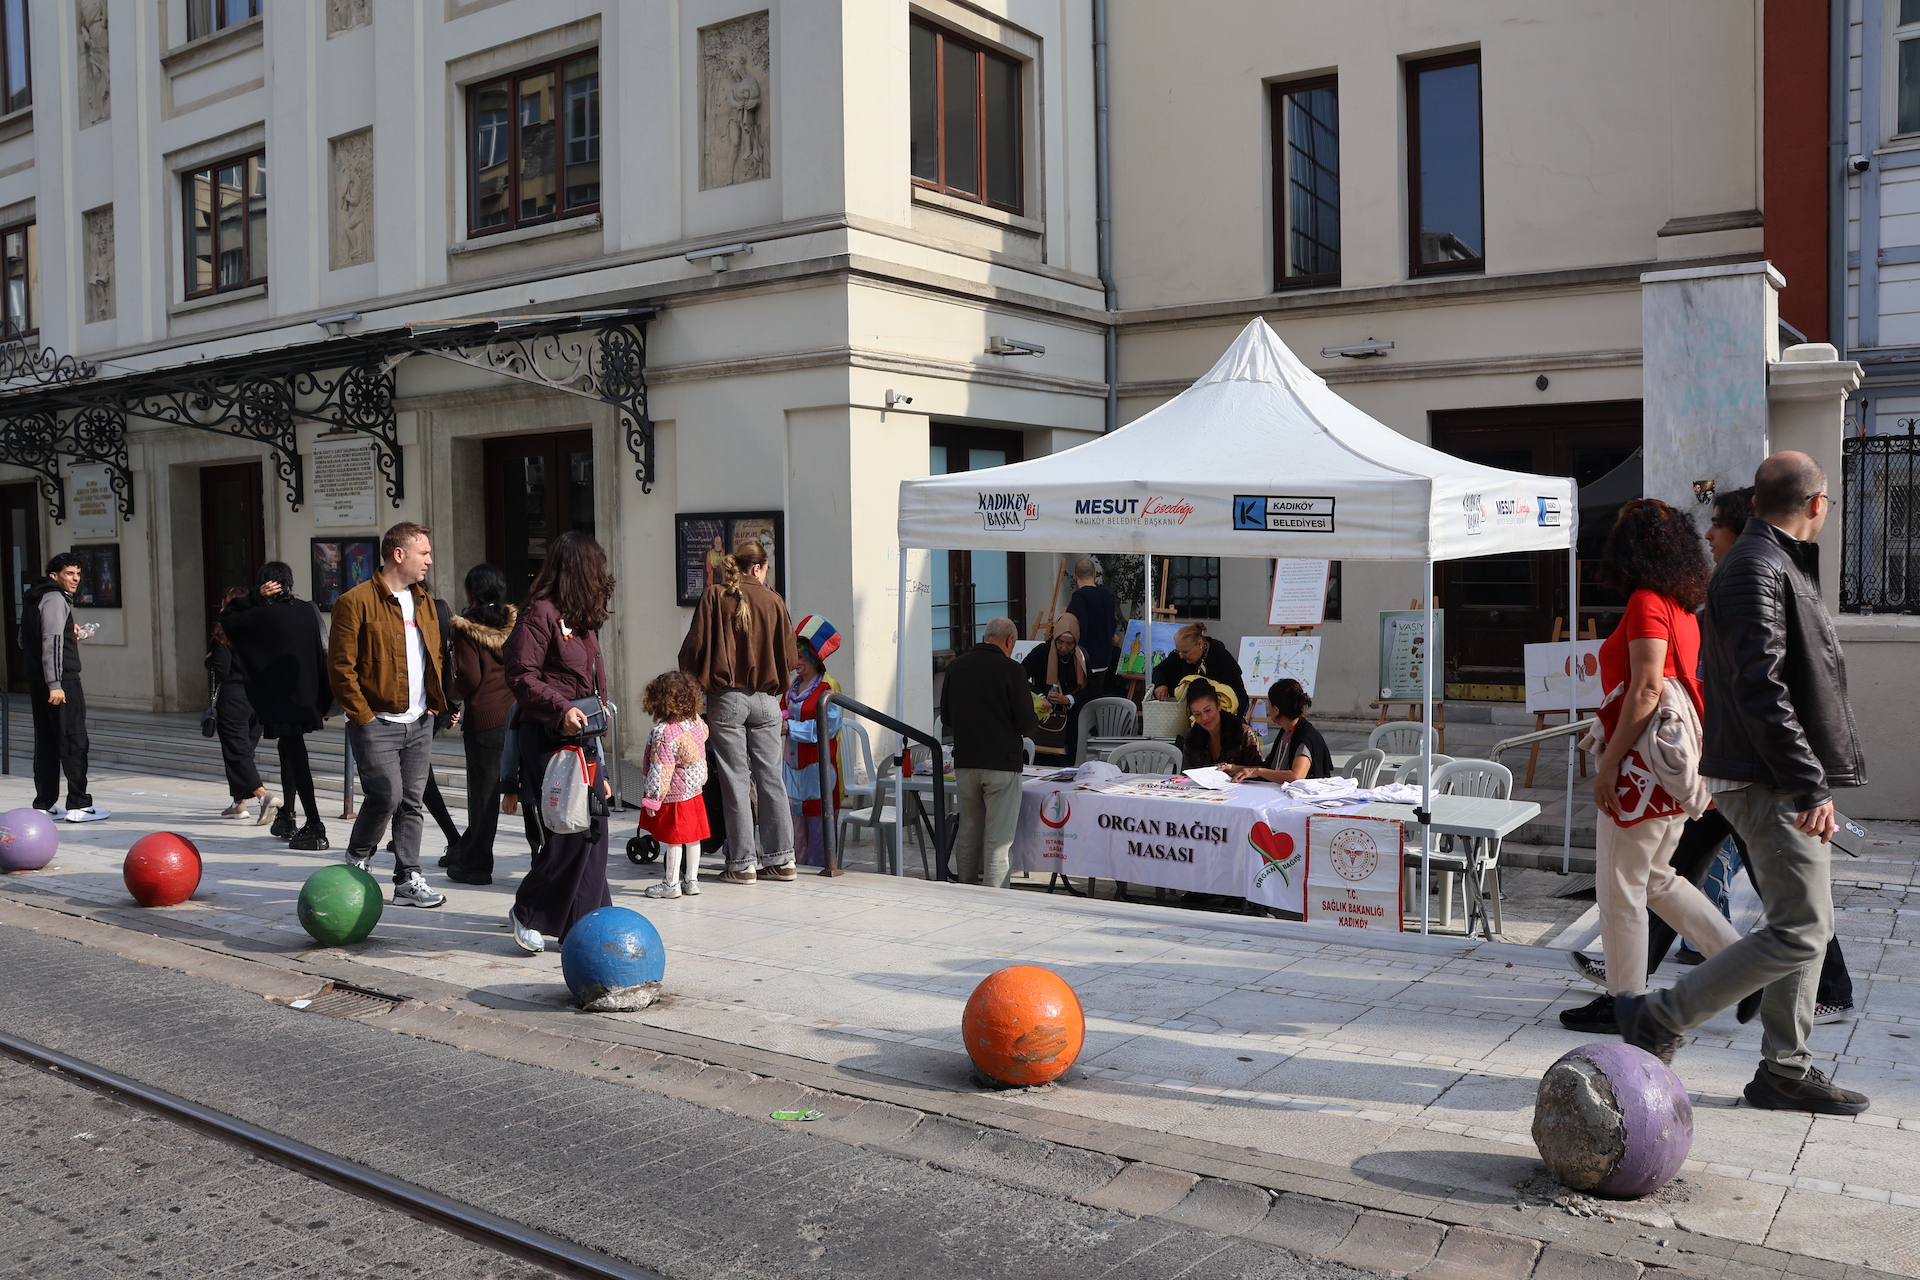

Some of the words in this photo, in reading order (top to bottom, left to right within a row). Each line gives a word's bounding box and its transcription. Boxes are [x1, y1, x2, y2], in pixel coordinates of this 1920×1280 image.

[978, 492, 1030, 511] KADIKÖY
[1273, 501, 1314, 511] KADIKÖY
[1075, 499, 1139, 514] MESUT
[1140, 496, 1195, 525] Kösedağı
[986, 511, 1021, 528] BAŞKA
[1075, 516, 1105, 525] KADIKÖY
[1107, 515, 1141, 525] BELEDİYE
[1144, 517, 1176, 527] BAŞKANI
[1273, 517, 1326, 528] BELEDİYESİ
[1097, 813, 1161, 835] ORGAN
[1165, 821, 1228, 844] BAĞIŞI
[1127, 840, 1194, 863] MASASI
[1255, 866, 1276, 888] ORGAN
[1282, 853, 1302, 870] BAĞIŞI
[1346, 889, 1358, 900] T.C.
[1321, 899, 1347, 913] SAĞLIK
[1348, 903, 1385, 917] BAKANLIĞI
[1338, 916, 1369, 929] KADIKÖY
